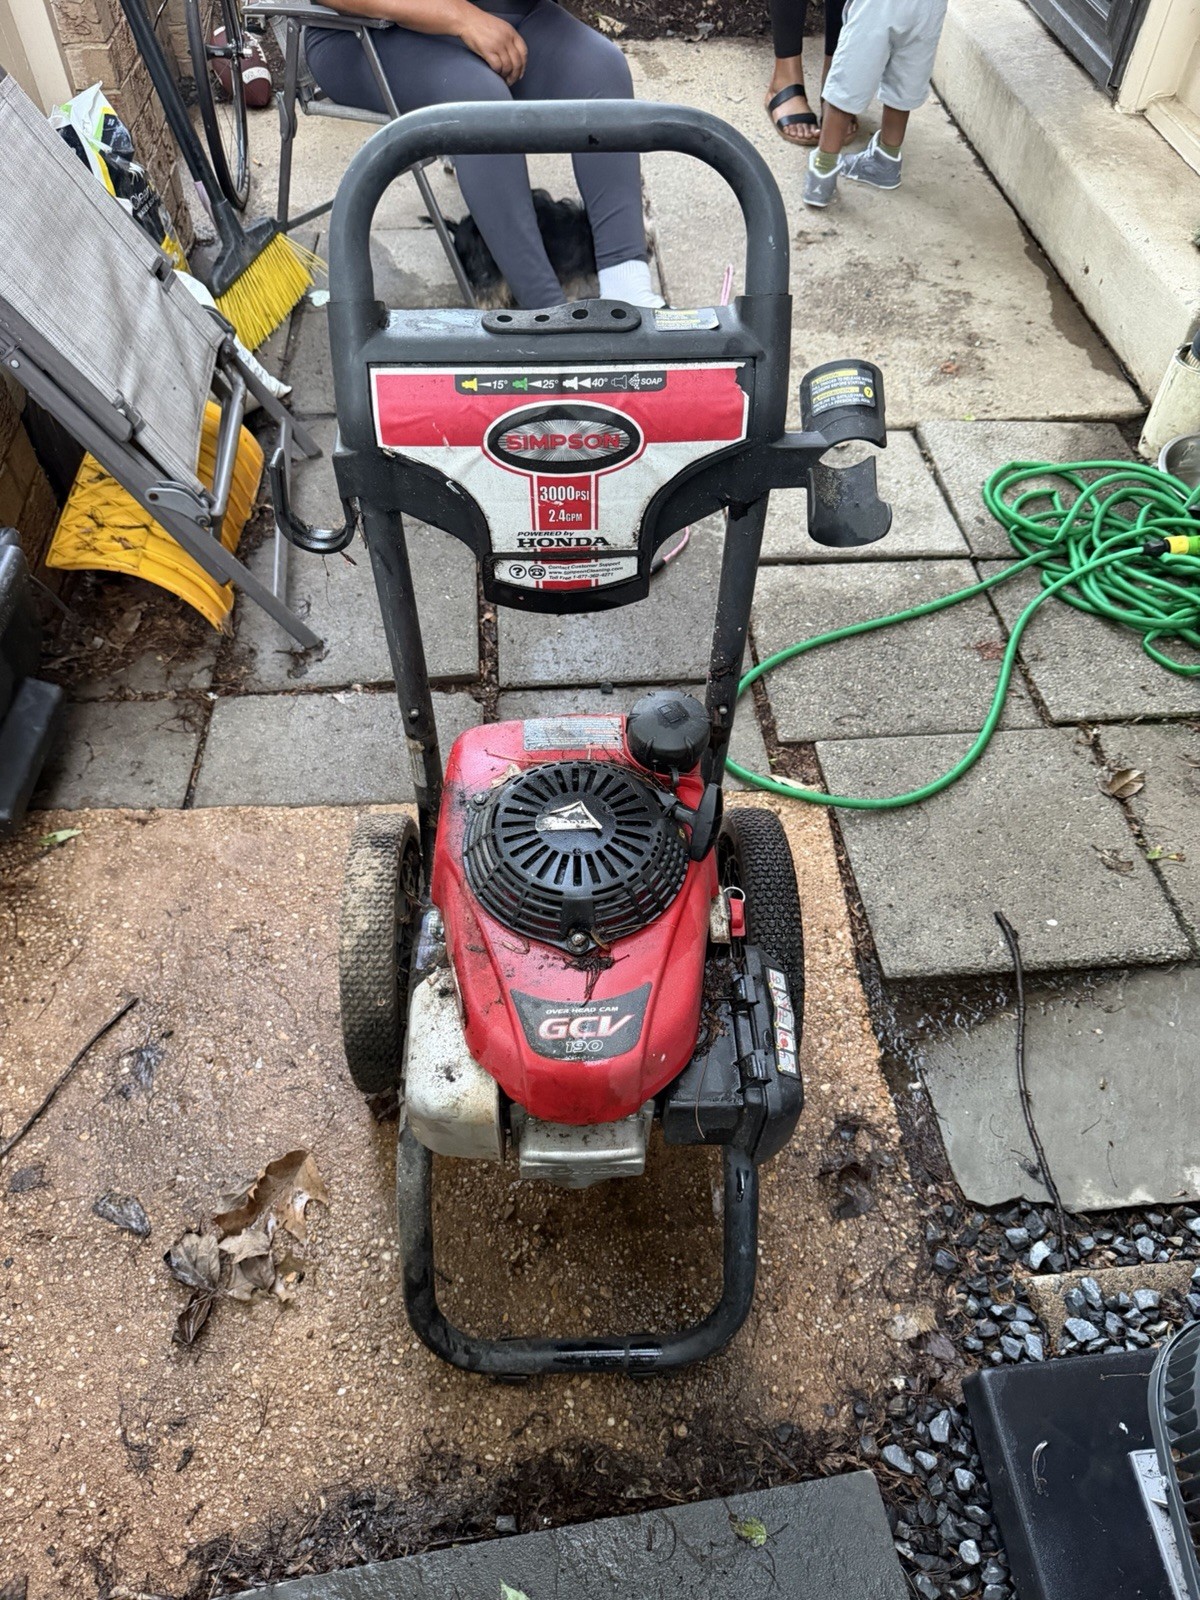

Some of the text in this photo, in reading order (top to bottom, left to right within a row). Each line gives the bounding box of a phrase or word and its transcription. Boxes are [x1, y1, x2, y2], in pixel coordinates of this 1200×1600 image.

[491, 379, 508, 390] 15°
[542, 379, 559, 389] 25°
[591, 378, 608, 387] 40°
[640, 377, 663, 386] SOAP
[506, 433, 620, 451] SIMPSON
[539, 485, 590, 501] 3000PSI
[548, 509, 583, 523] 2.4GPM
[516, 537, 611, 548] HONDA
[538, 1013, 636, 1040] GCV
[565, 1039, 604, 1054] 190
